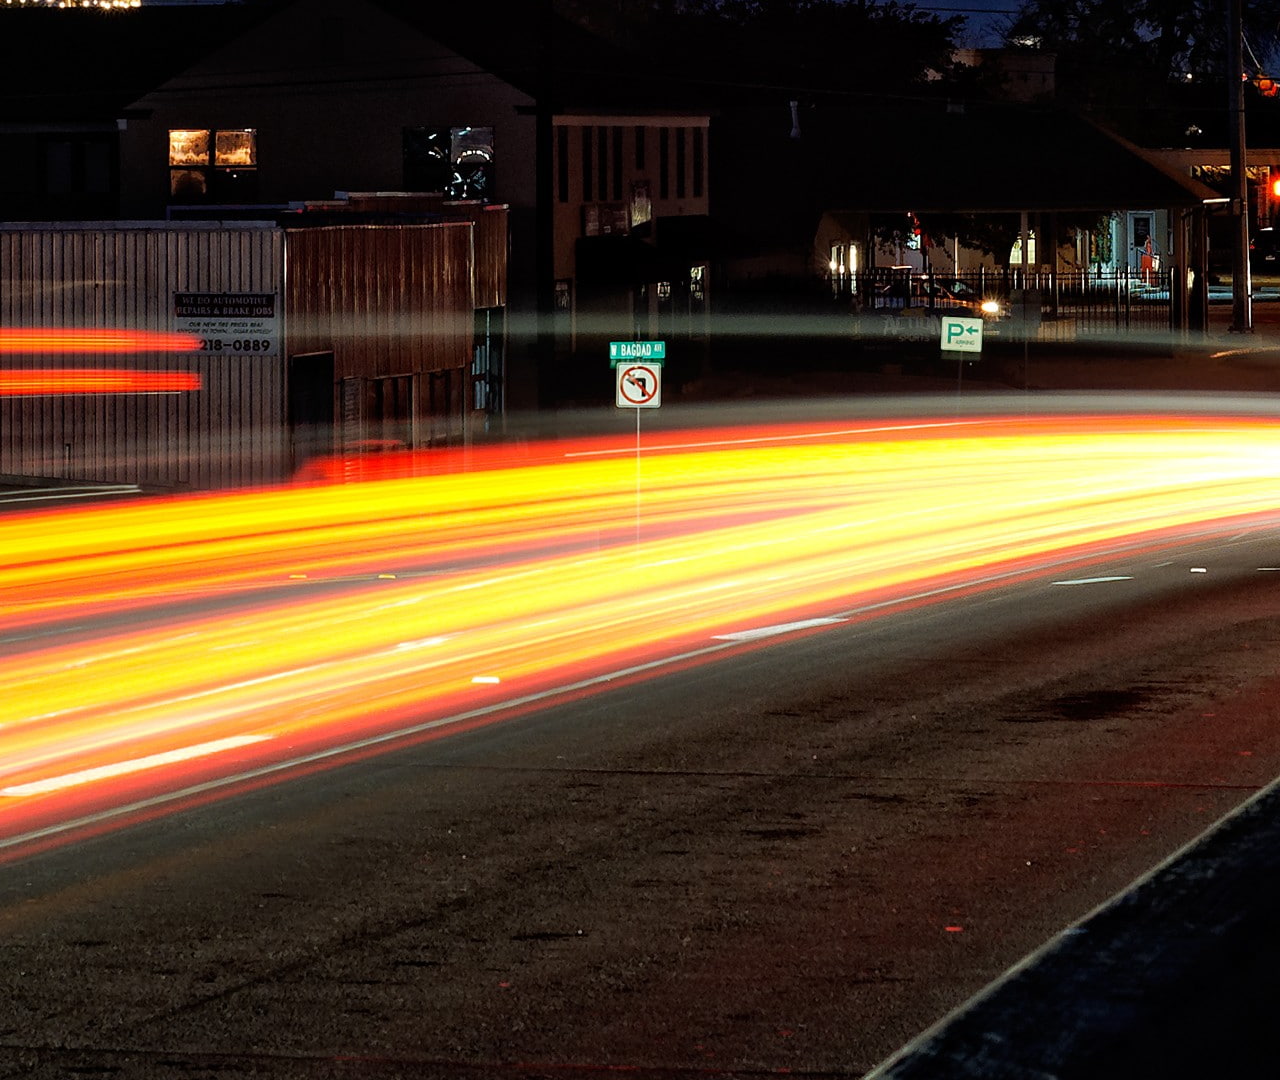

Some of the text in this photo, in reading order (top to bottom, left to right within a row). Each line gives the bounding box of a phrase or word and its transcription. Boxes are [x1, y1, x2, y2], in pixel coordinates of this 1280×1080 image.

[176, 306, 273, 316] REPAIRS & BRAKE JOBS
[199, 339, 270, 351] 218-0889
[610, 344, 617, 356] W
[621, 344, 651, 357] BAGDAD
